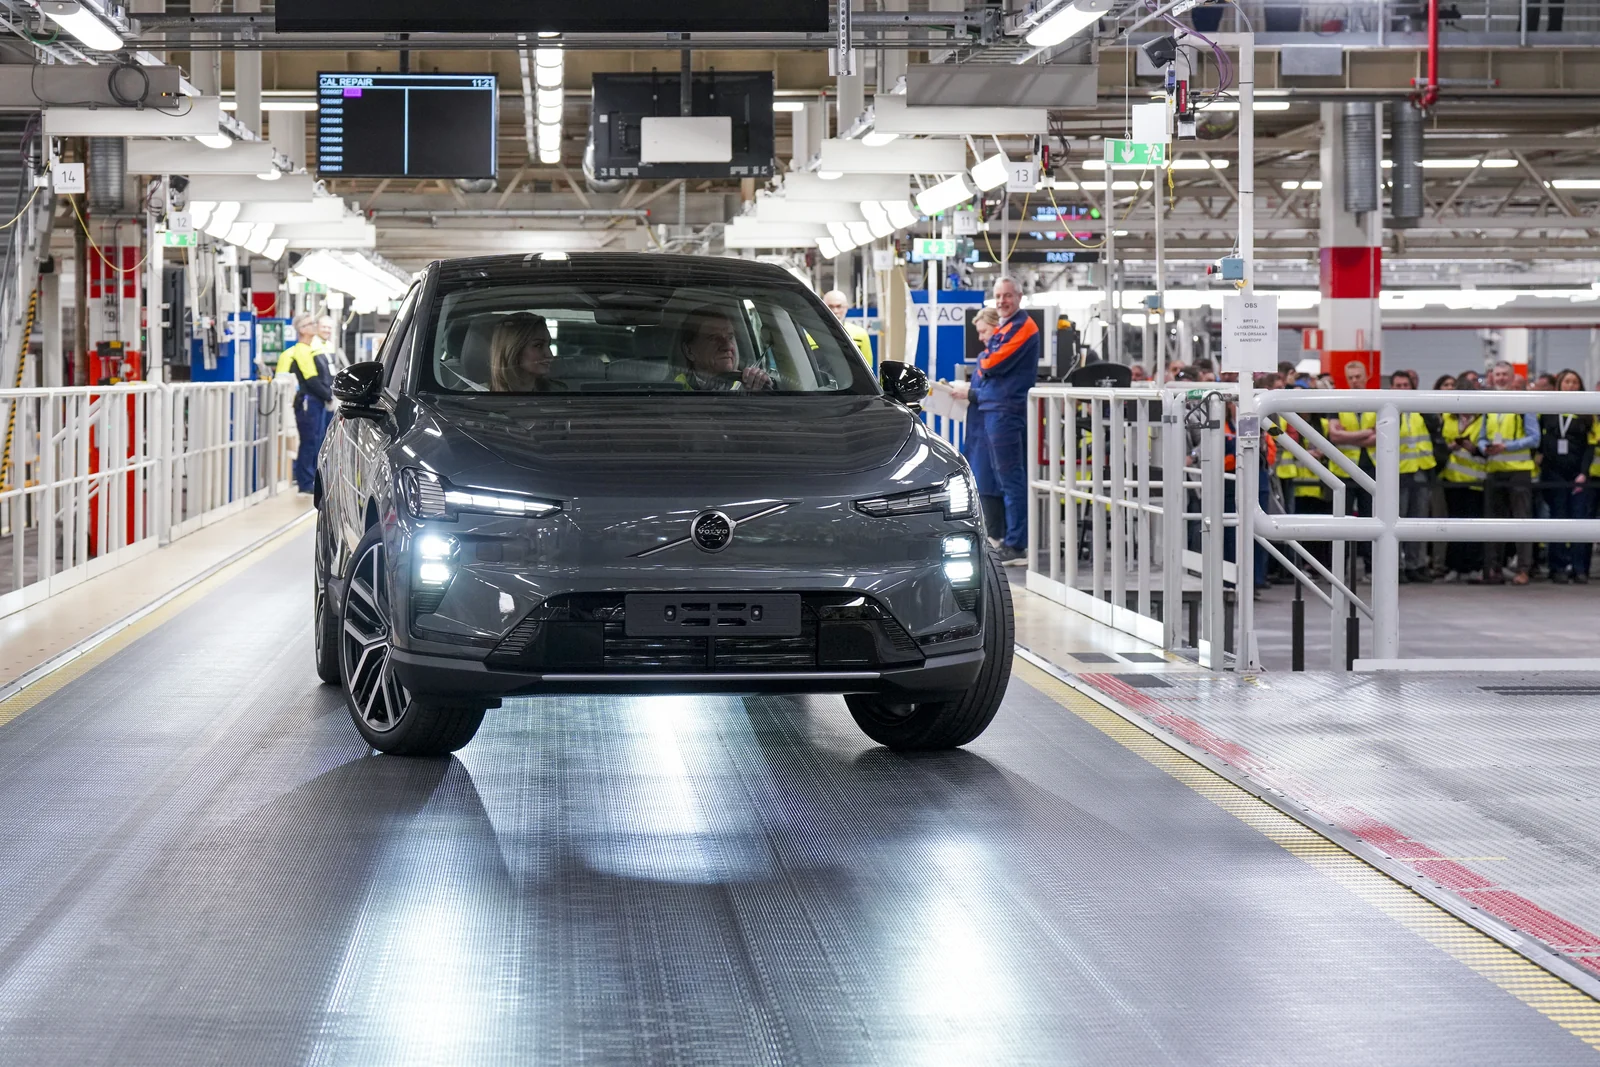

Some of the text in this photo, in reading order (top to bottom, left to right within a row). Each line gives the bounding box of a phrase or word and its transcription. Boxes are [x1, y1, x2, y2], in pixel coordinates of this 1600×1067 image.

[320, 78, 373, 86] CAL REPAIR
[61, 170, 76, 183] 14
[1015, 169, 1029, 182] 13
[176, 217, 188, 228] 12
[1046, 252, 1075, 262] RAST
